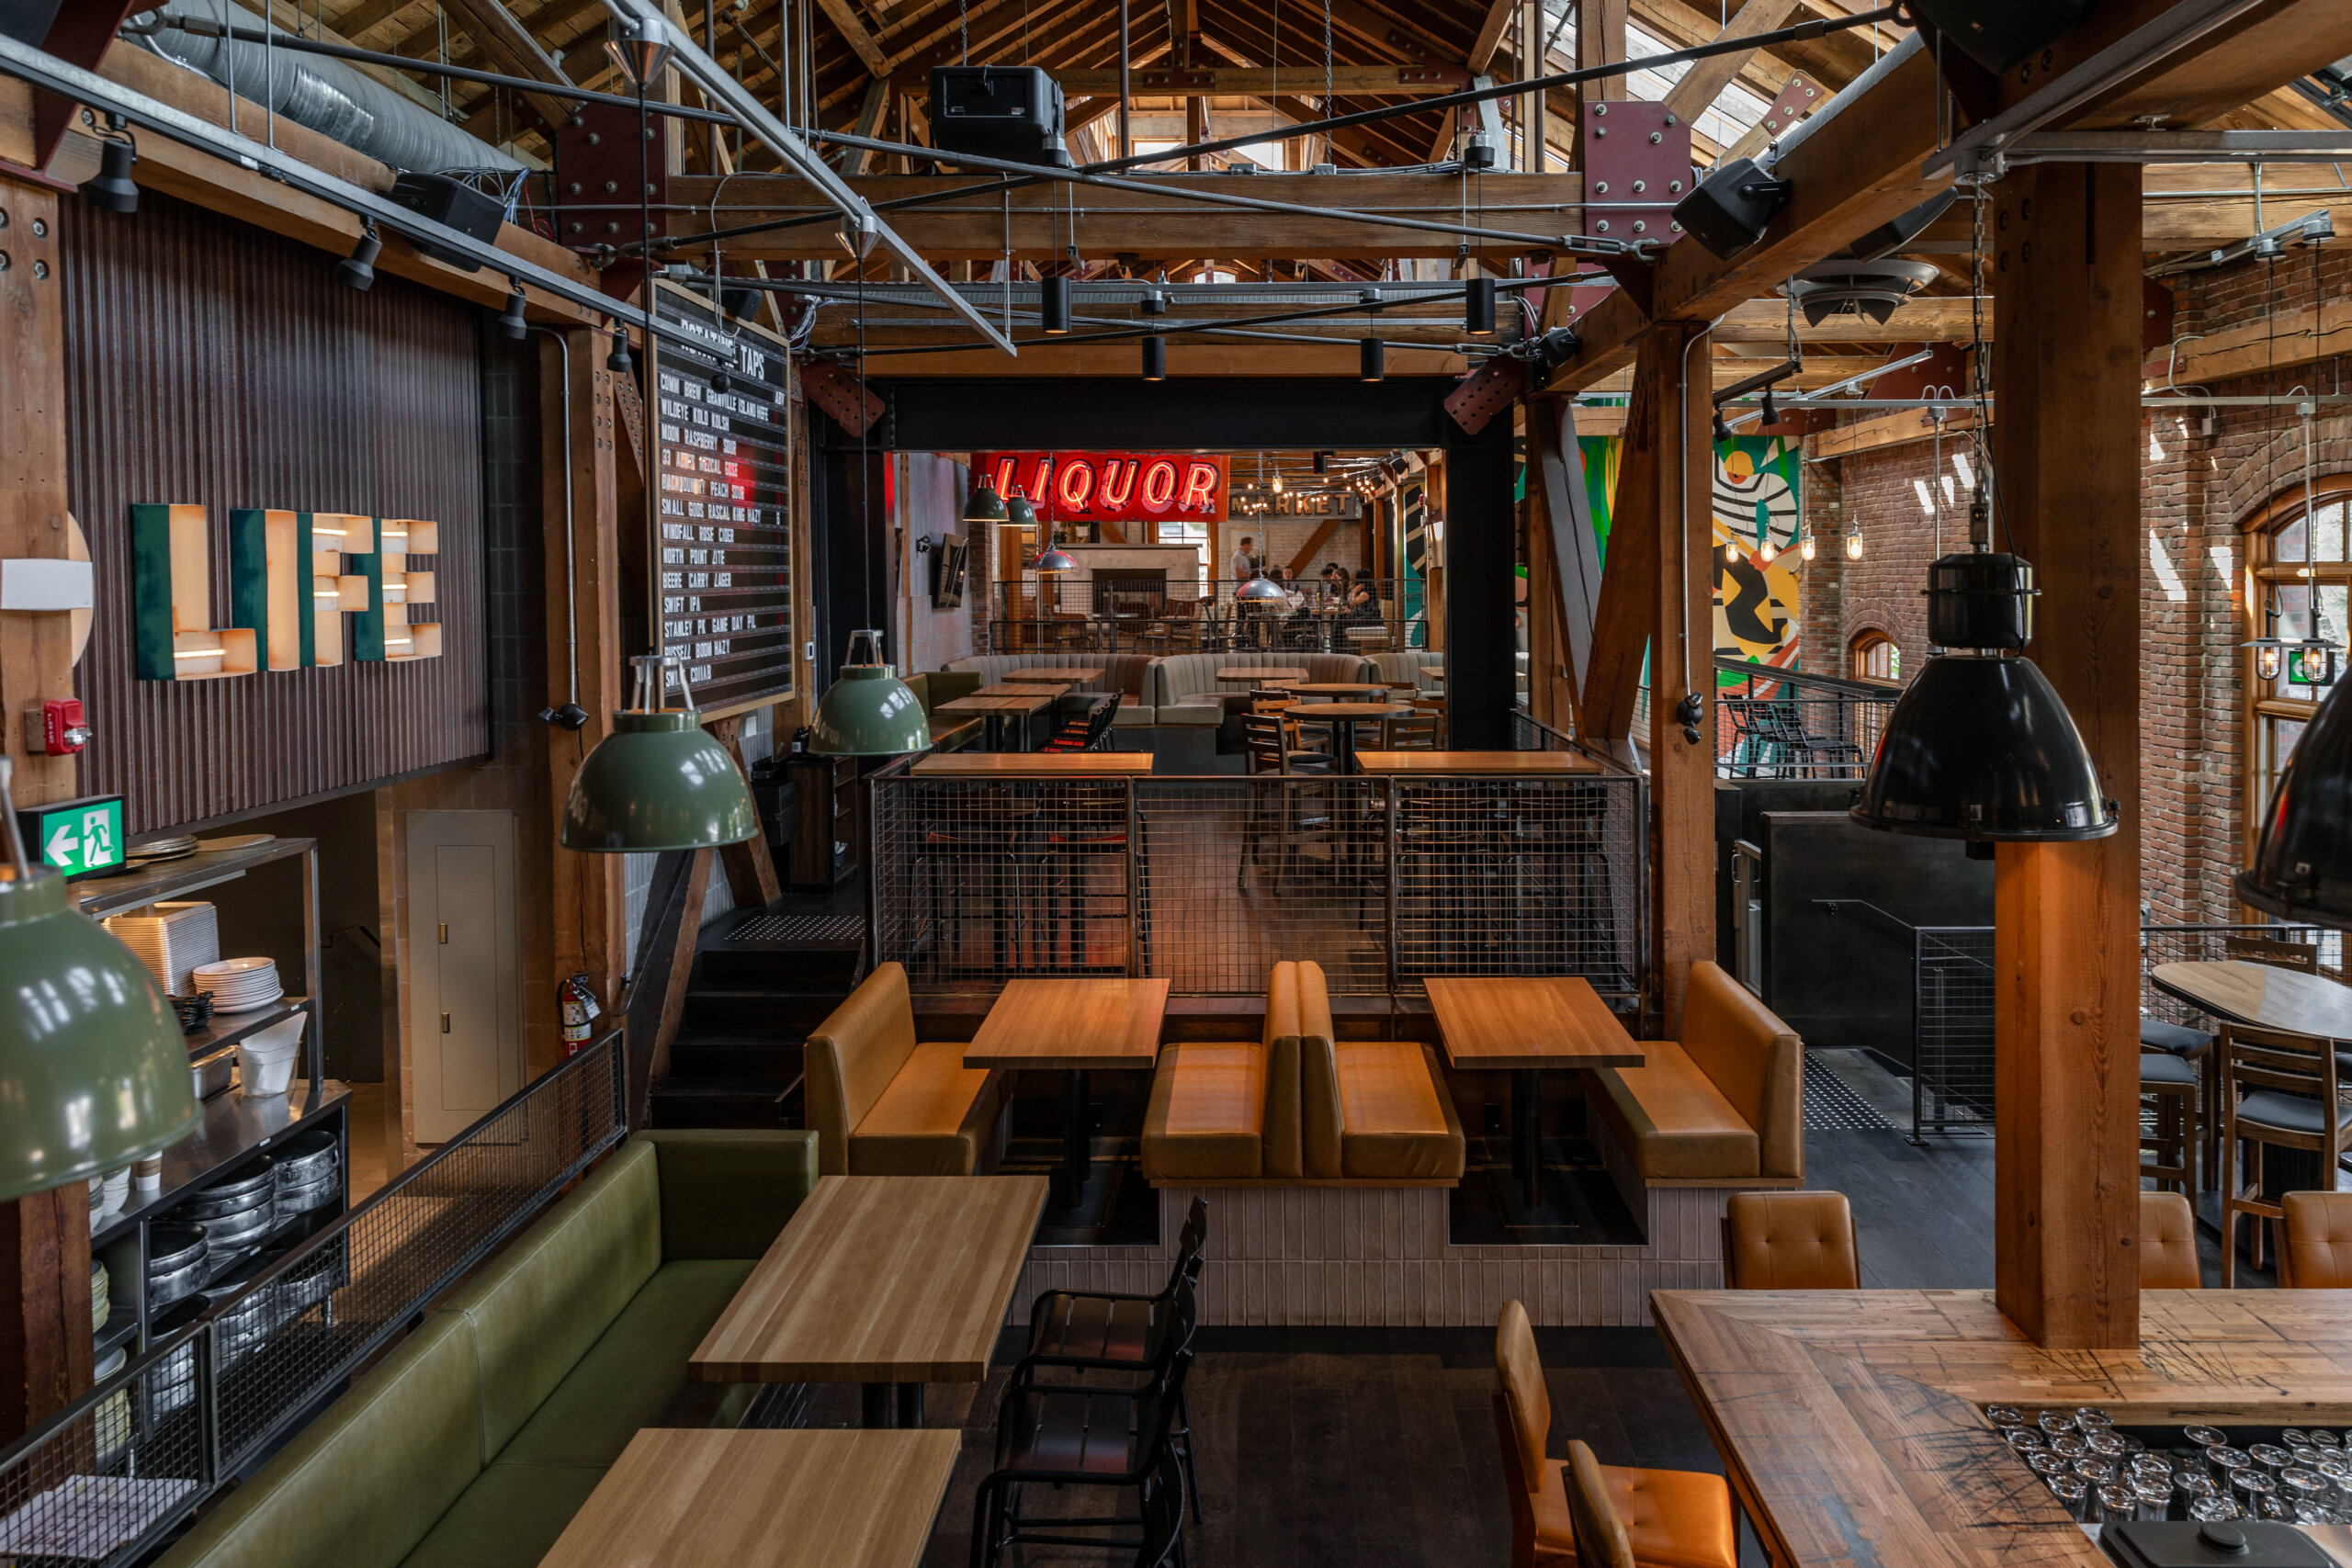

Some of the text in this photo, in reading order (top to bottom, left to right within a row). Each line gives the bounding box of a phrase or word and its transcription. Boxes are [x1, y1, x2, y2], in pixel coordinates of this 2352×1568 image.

[741, 344, 764, 380] TAPS
[661, 373, 680, 394] COMM
[684, 380, 701, 401] BREW
[707, 387, 736, 412] GRANVILLE
[738, 398, 756, 418] ISLAND
[757, 404, 768, 422] HEFE
[775, 390, 786, 405] ABV
[662, 398, 729, 432] WILDEYE KOLD KOLSH
[662, 423, 737, 455] MOON RASPBERRY SOUR
[662, 448, 671, 466] 33
[710, 480, 729, 498] PEACH
[992, 457, 1220, 513] LIQUOR
[662, 498, 684, 516] SMALL
[688, 501, 704, 518] GODS
[707, 503, 730, 521] RASCAL
[747, 508, 761, 524] HAZY
[1231, 492, 1351, 514] MARKET
[662, 523, 734, 543] WINDFALL ROSE CIDER
[662, 547, 684, 564] NORTH
[690, 549, 707, 565] POINT
[662, 572, 731, 589] BEERE CARRY LAGER
[132, 503, 442, 681] LIFE
[664, 596, 701, 614] SWIFT IPA
[664, 620, 693, 638] STANLEY
[697, 619, 707, 635] PK
[712, 617, 729, 633] GAME
[731, 615, 743, 631] DAY
[695, 641, 712, 659] BOOM
[714, 639, 730, 656] HAZY
